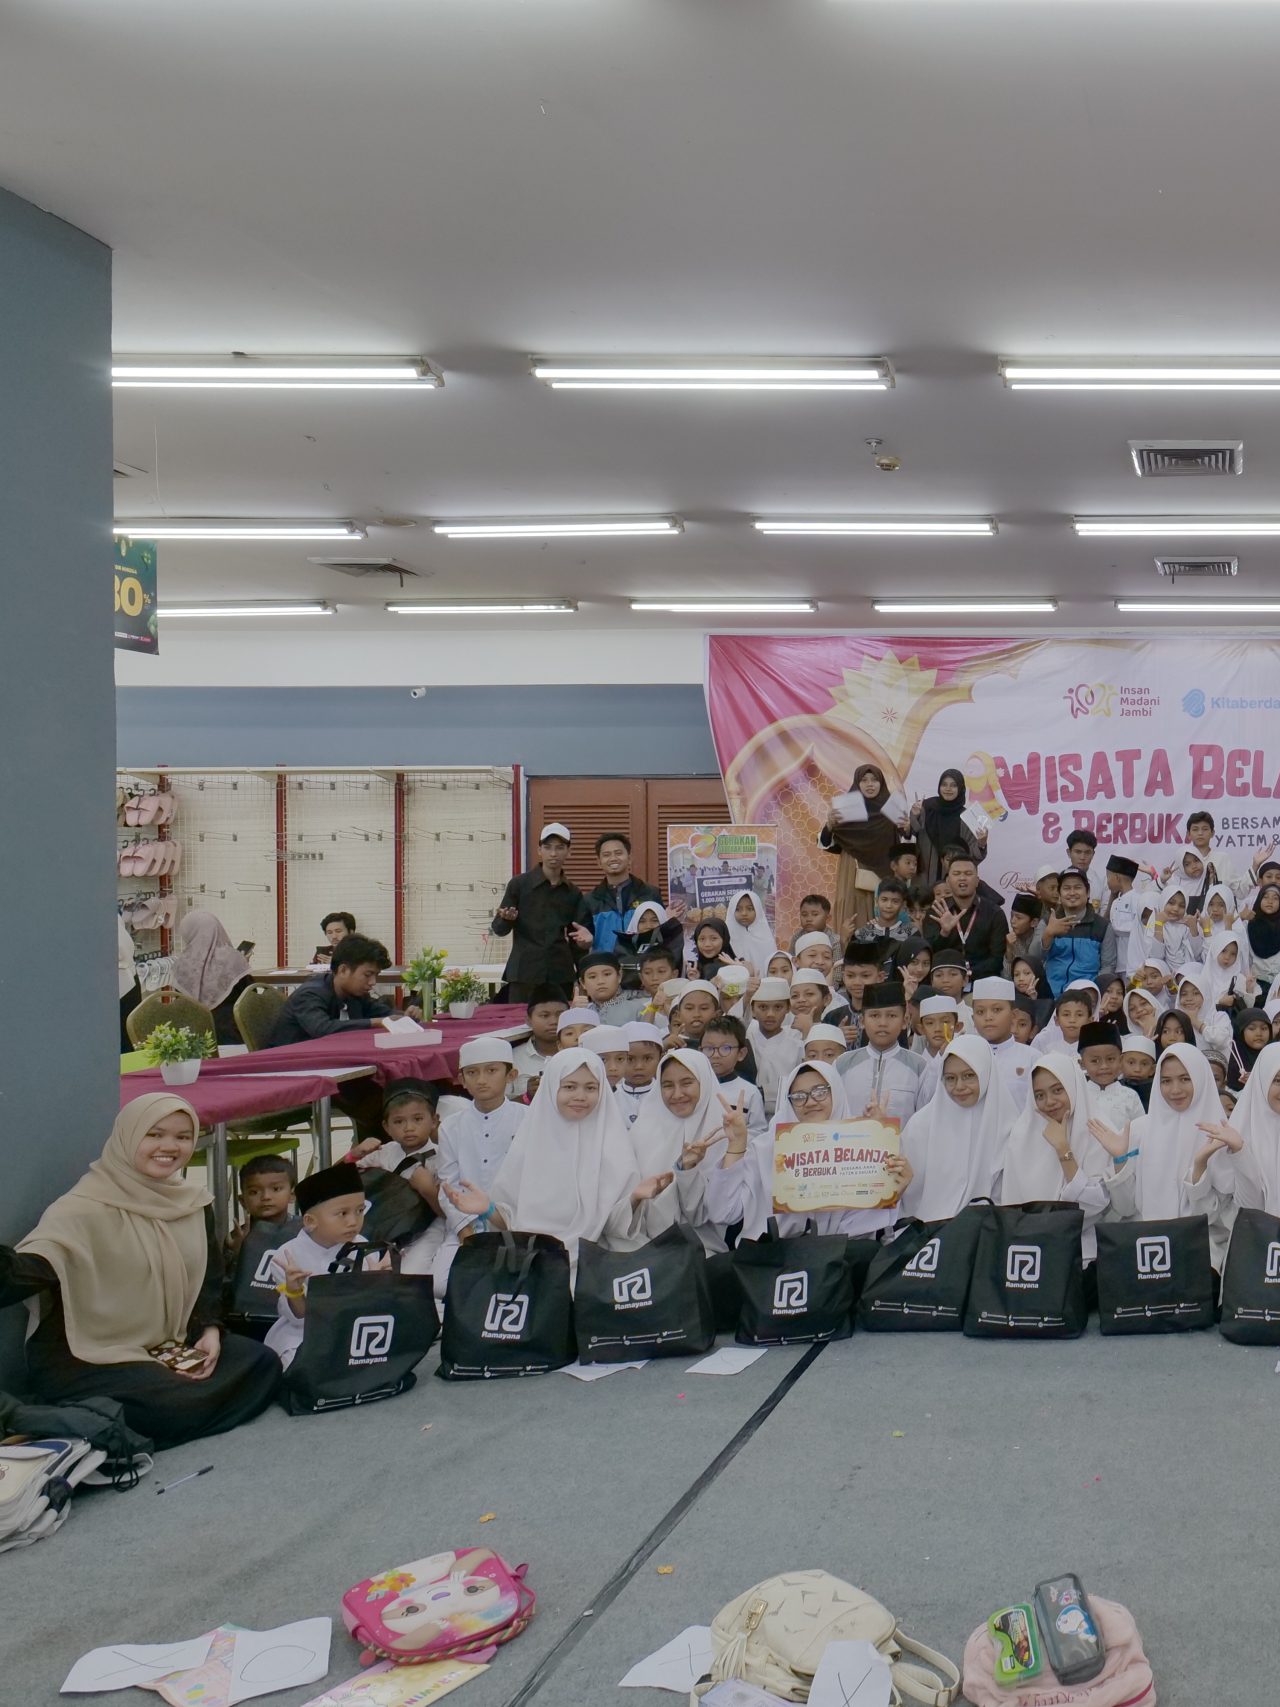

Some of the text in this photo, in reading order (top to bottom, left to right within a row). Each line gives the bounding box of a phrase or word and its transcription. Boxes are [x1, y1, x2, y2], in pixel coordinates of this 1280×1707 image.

[1120, 686, 1150, 695] Insan
[1120, 697, 1160, 706] Madani
[1120, 707, 1152, 717] Jambi
[994, 748, 1174, 816] WISATA
[1042, 809, 1193, 845] & BERBUK
[1215, 833, 1267, 848] YATIM
[1272, 833, 1280, 846] &
[784, 1147, 889, 1170] WISATA BELANJA
[802, 1166, 837, 1178] BERBUKA
[902, 1270, 936, 1279] Ramayana
[1137, 1272, 1171, 1280] Ramayana
[250, 1280, 277, 1290] Ramay
[1005, 1281, 1039, 1289] Ramayana
[614, 1300, 653, 1310] Ramayana
[772, 1307, 808, 1315] Ramayana
[481, 1330, 521, 1340] Ramayana
[348, 1357, 388, 1366] Ramayana
